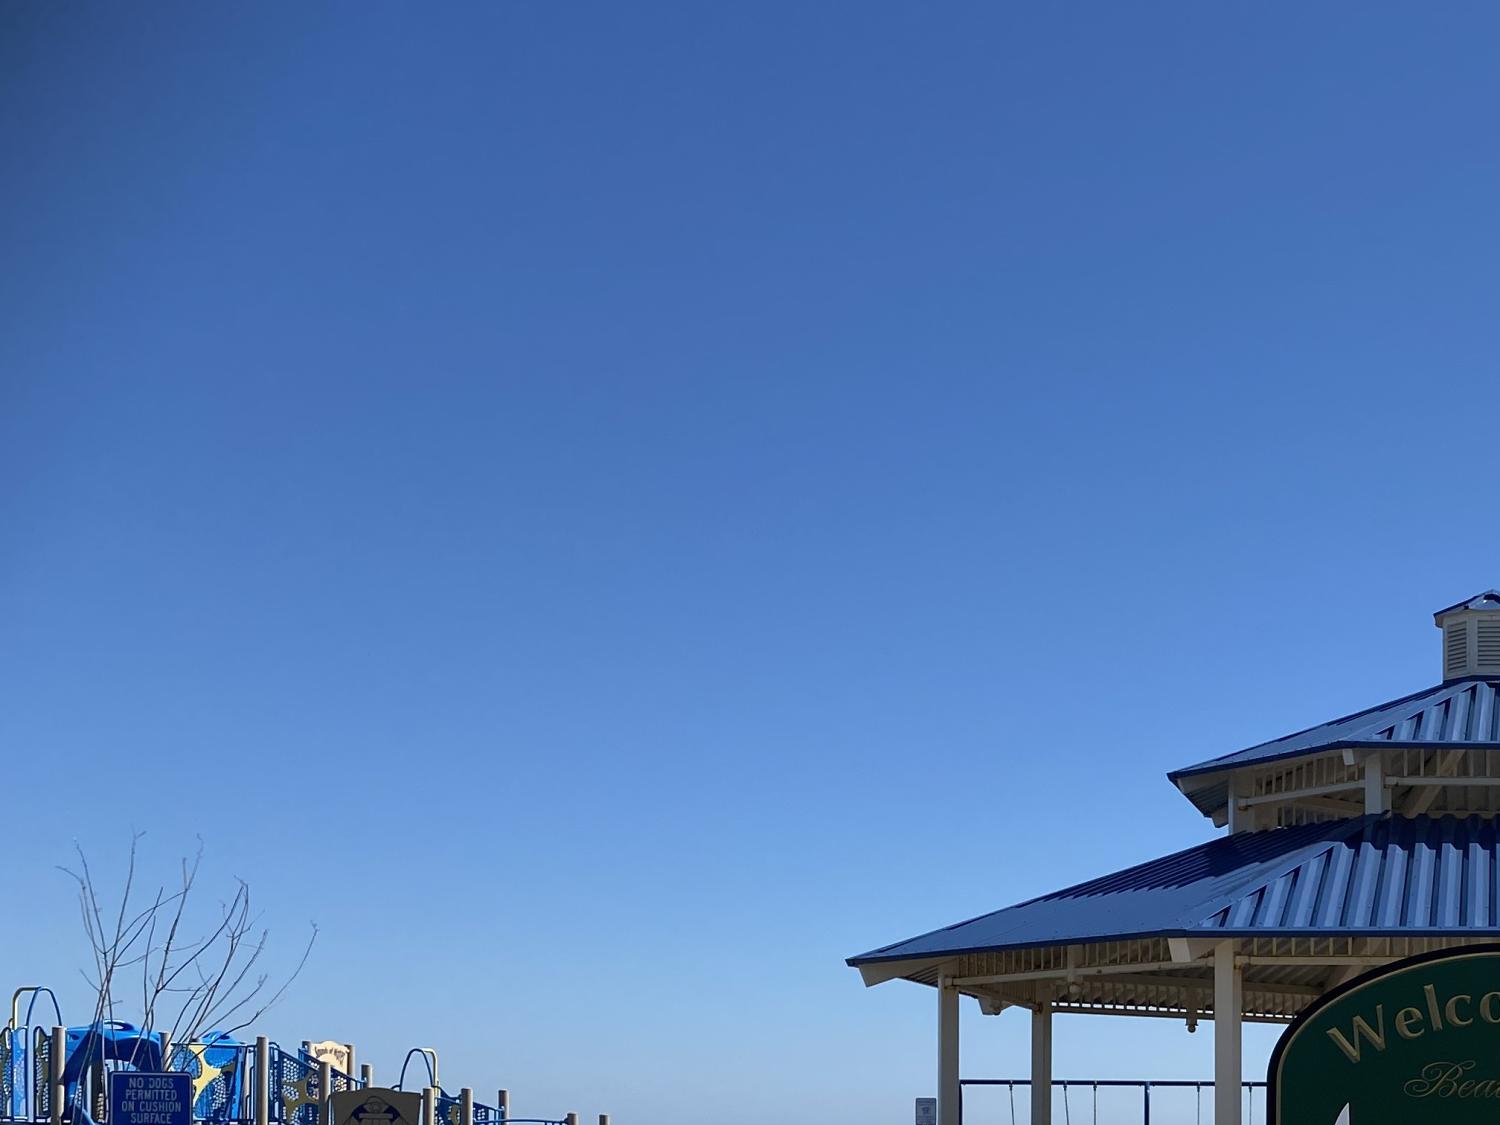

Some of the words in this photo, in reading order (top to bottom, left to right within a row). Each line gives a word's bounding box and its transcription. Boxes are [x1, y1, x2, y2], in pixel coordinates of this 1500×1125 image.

[129, 1078, 144, 1089] NO
[149, 1078, 174, 1089] DOGS
[125, 1089, 177, 1101] PERMITTED
[121, 1101, 135, 1112] ON
[140, 1101, 182, 1113] CUSHION
[130, 1113, 172, 1124] SURFACE
